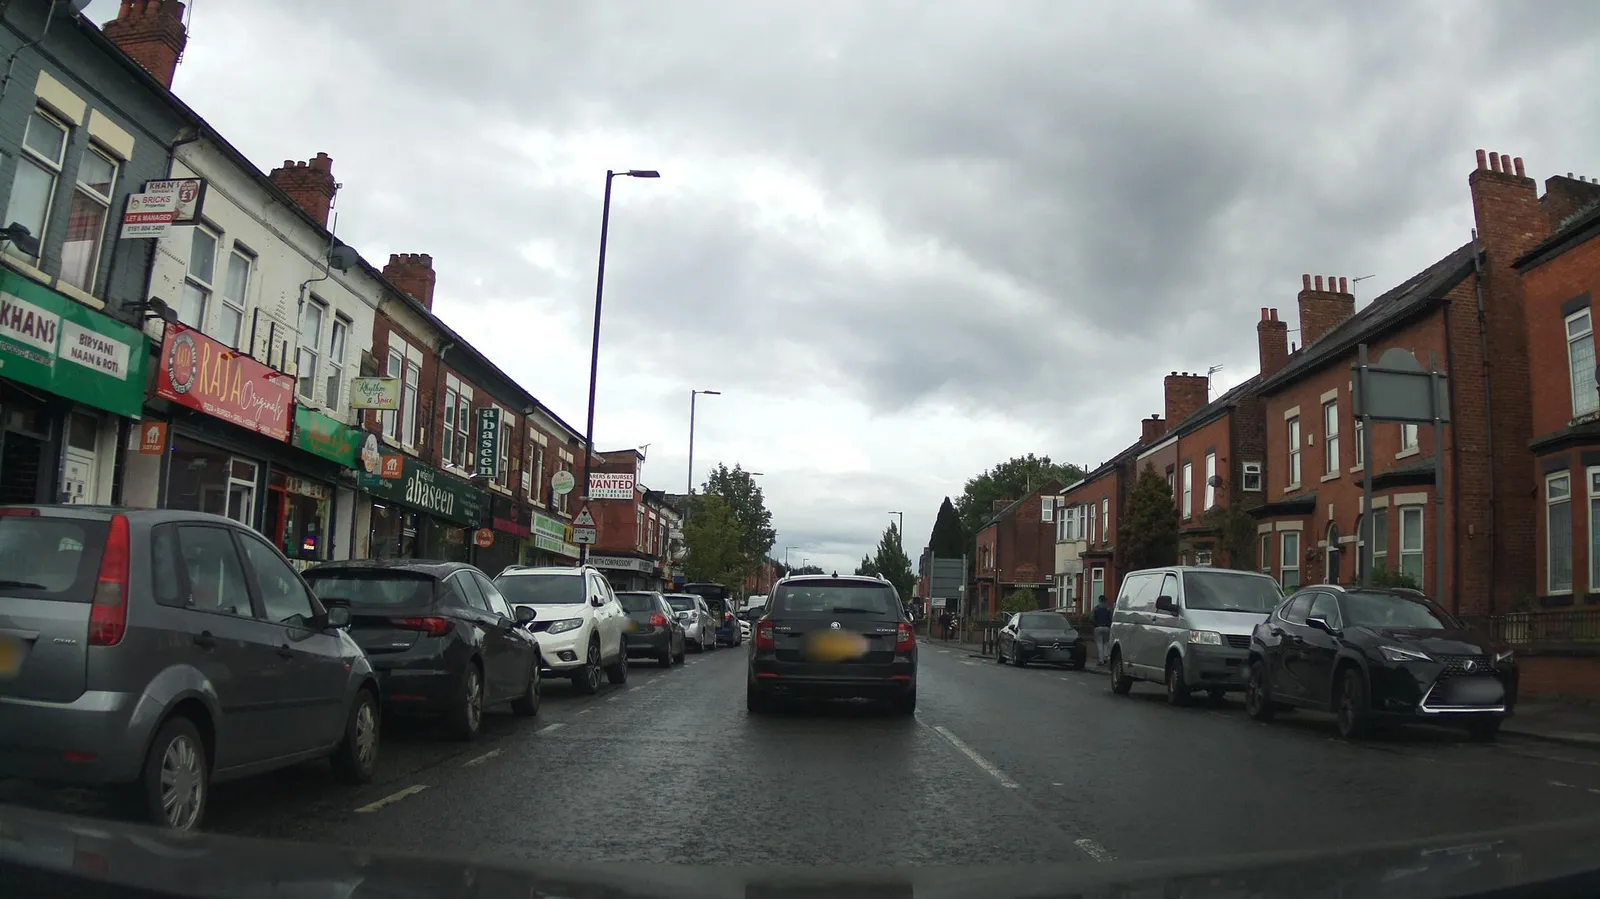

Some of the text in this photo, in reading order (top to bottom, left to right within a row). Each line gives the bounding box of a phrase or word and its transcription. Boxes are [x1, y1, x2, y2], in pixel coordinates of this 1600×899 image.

[142, 195, 171, 204] BRICKS
[181, 189, 194, 201] £1
[0, 300, 56, 344] KHAN'S
[79, 332, 114, 356] BIRYANI
[70, 347, 95, 366] NAAN
[95, 358, 102, 367] &
[102, 359, 119, 373] ROTI
[199, 342, 241, 405] RAJA
[241, 380, 283, 421] Originals
[357, 381, 386, 396] Rhythm
[375, 392, 393, 407] Spice
[481, 409, 495, 475] abaseen
[406, 469, 454, 516] abaseen
